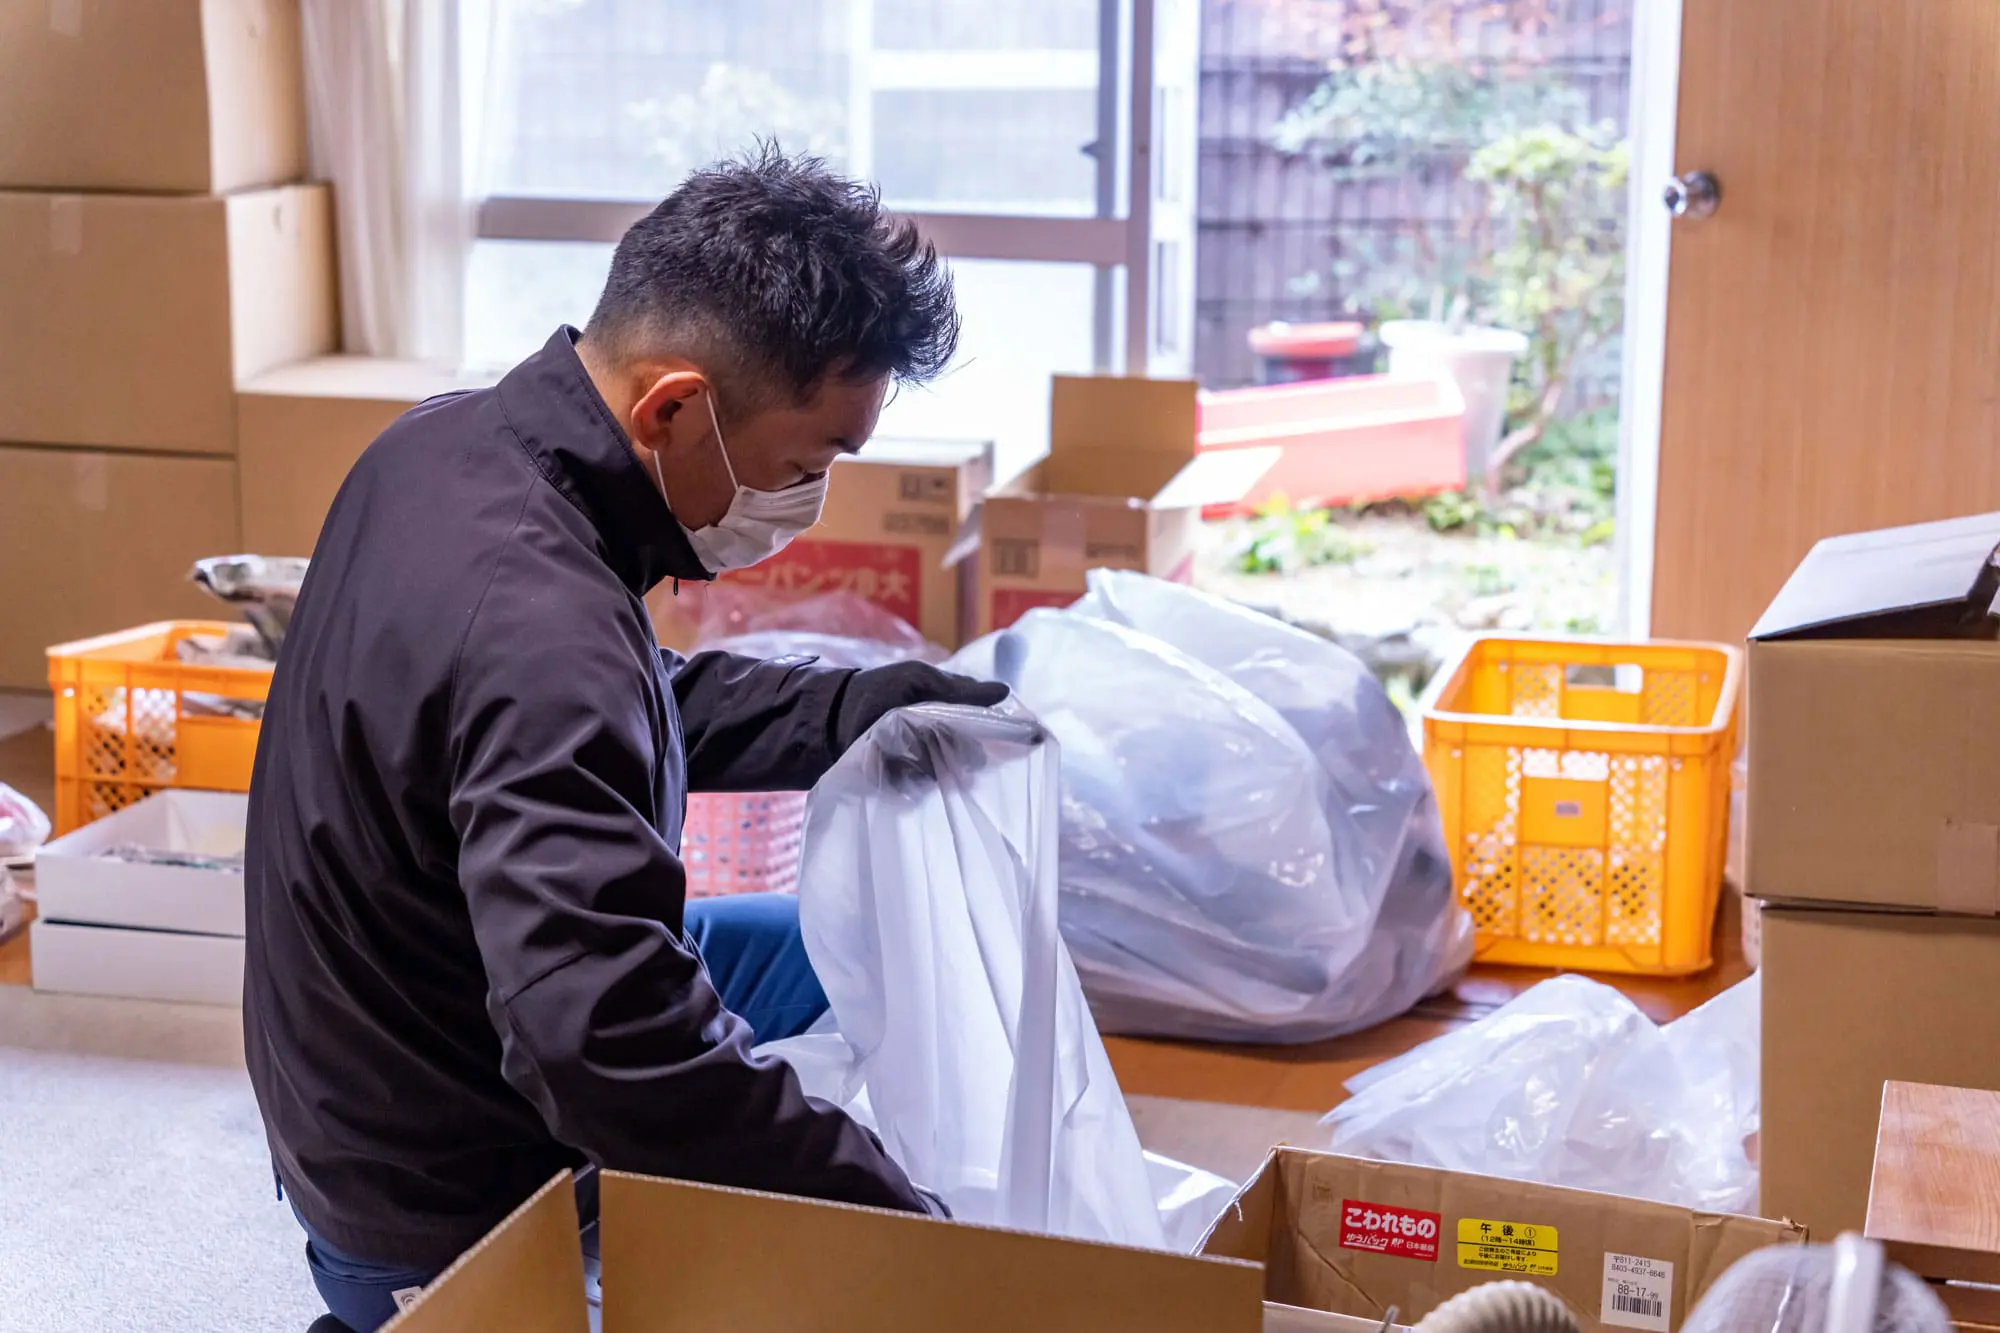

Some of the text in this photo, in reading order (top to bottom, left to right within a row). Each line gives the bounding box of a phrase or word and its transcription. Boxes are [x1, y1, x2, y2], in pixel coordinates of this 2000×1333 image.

[1345, 1207, 1436, 1238] こわれもの
[1346, 1233, 1388, 1247] ゆうパック
